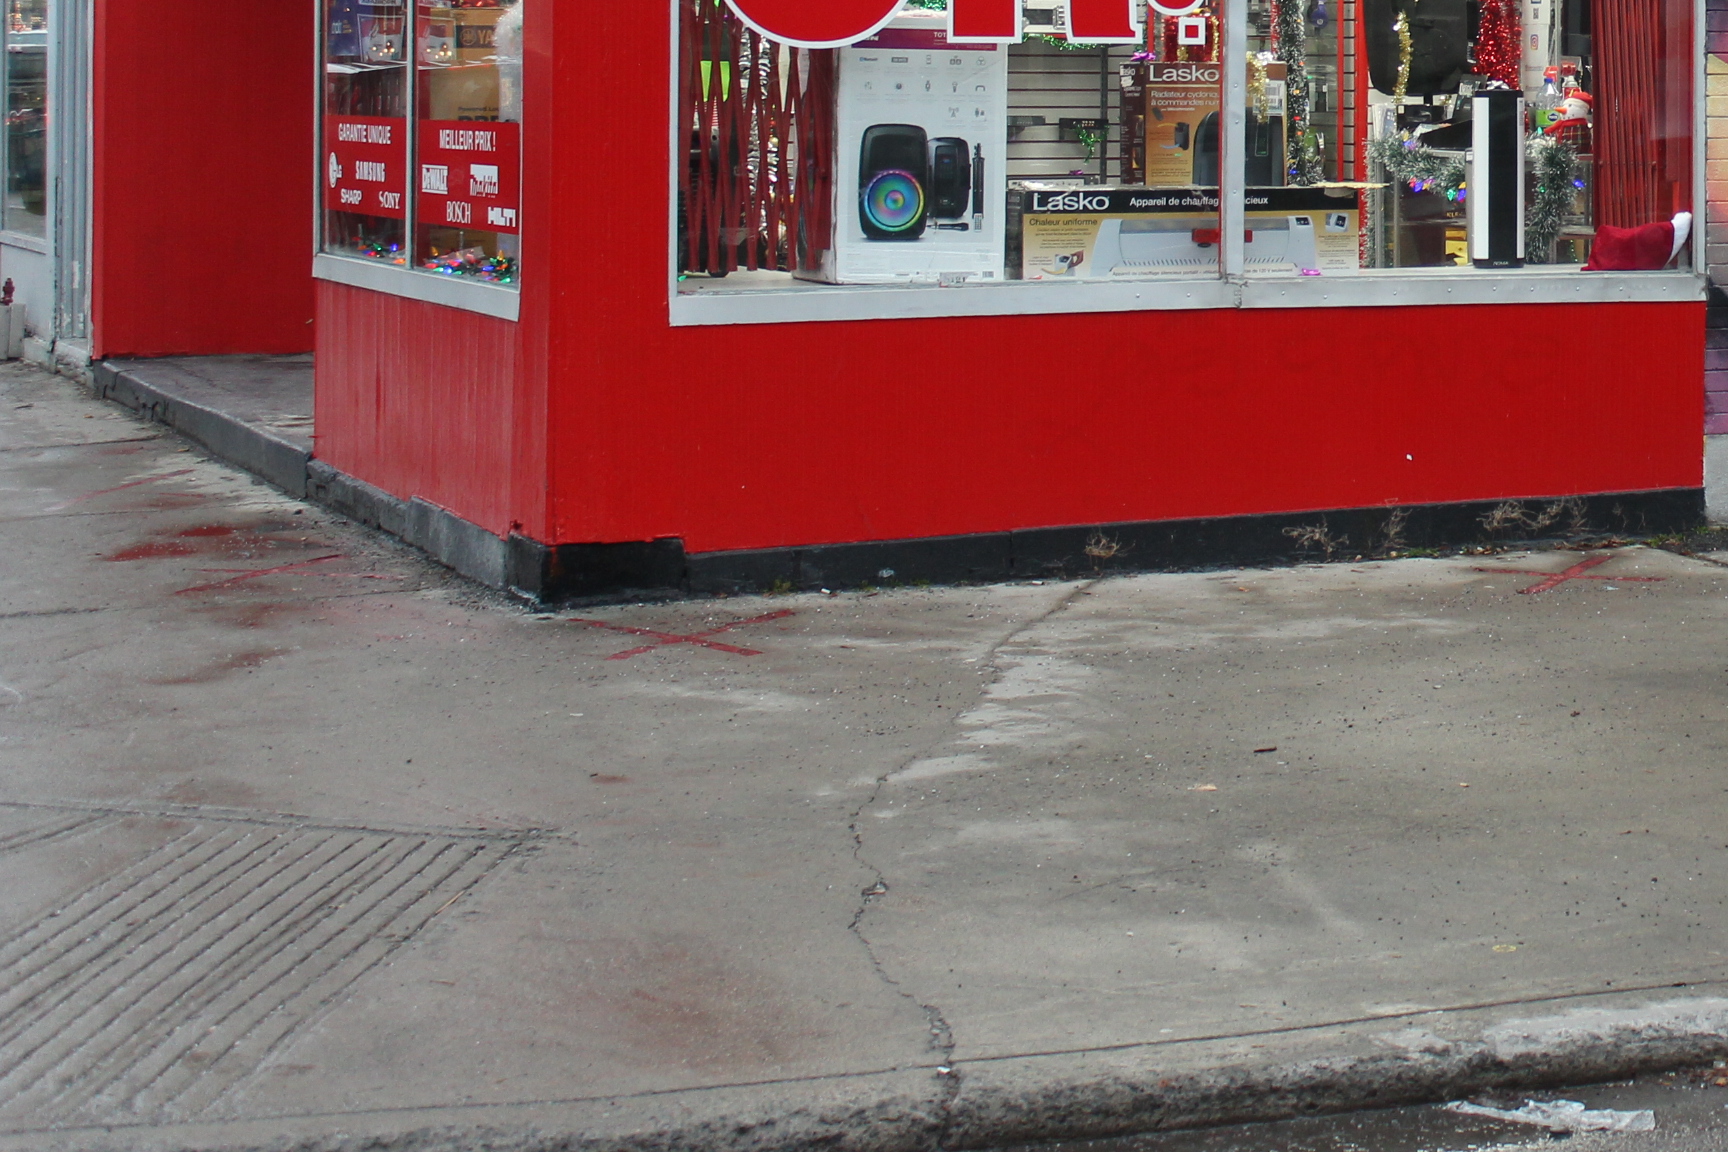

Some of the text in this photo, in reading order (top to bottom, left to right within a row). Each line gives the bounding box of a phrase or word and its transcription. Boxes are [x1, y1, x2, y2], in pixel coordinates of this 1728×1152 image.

[1149, 64, 1220, 82] Lasko
[338, 123, 391, 144] GARANTIE UNIQUE
[439, 129, 473, 151] MEILLEUR
[474, 131, 492, 151] PRIX
[356, 160, 386, 182] SAMSUNG
[340, 188, 400, 209] SHARP SONY
[1032, 192, 1110, 212] Lasko
[1129, 197, 1167, 207] Appareil
[1168, 197, 1180, 206] de
[1181, 197, 1219, 207] chauffag
[446, 201, 471, 224] BOSCH
[1029, 217, 1098, 227] Chaleur uniforme
